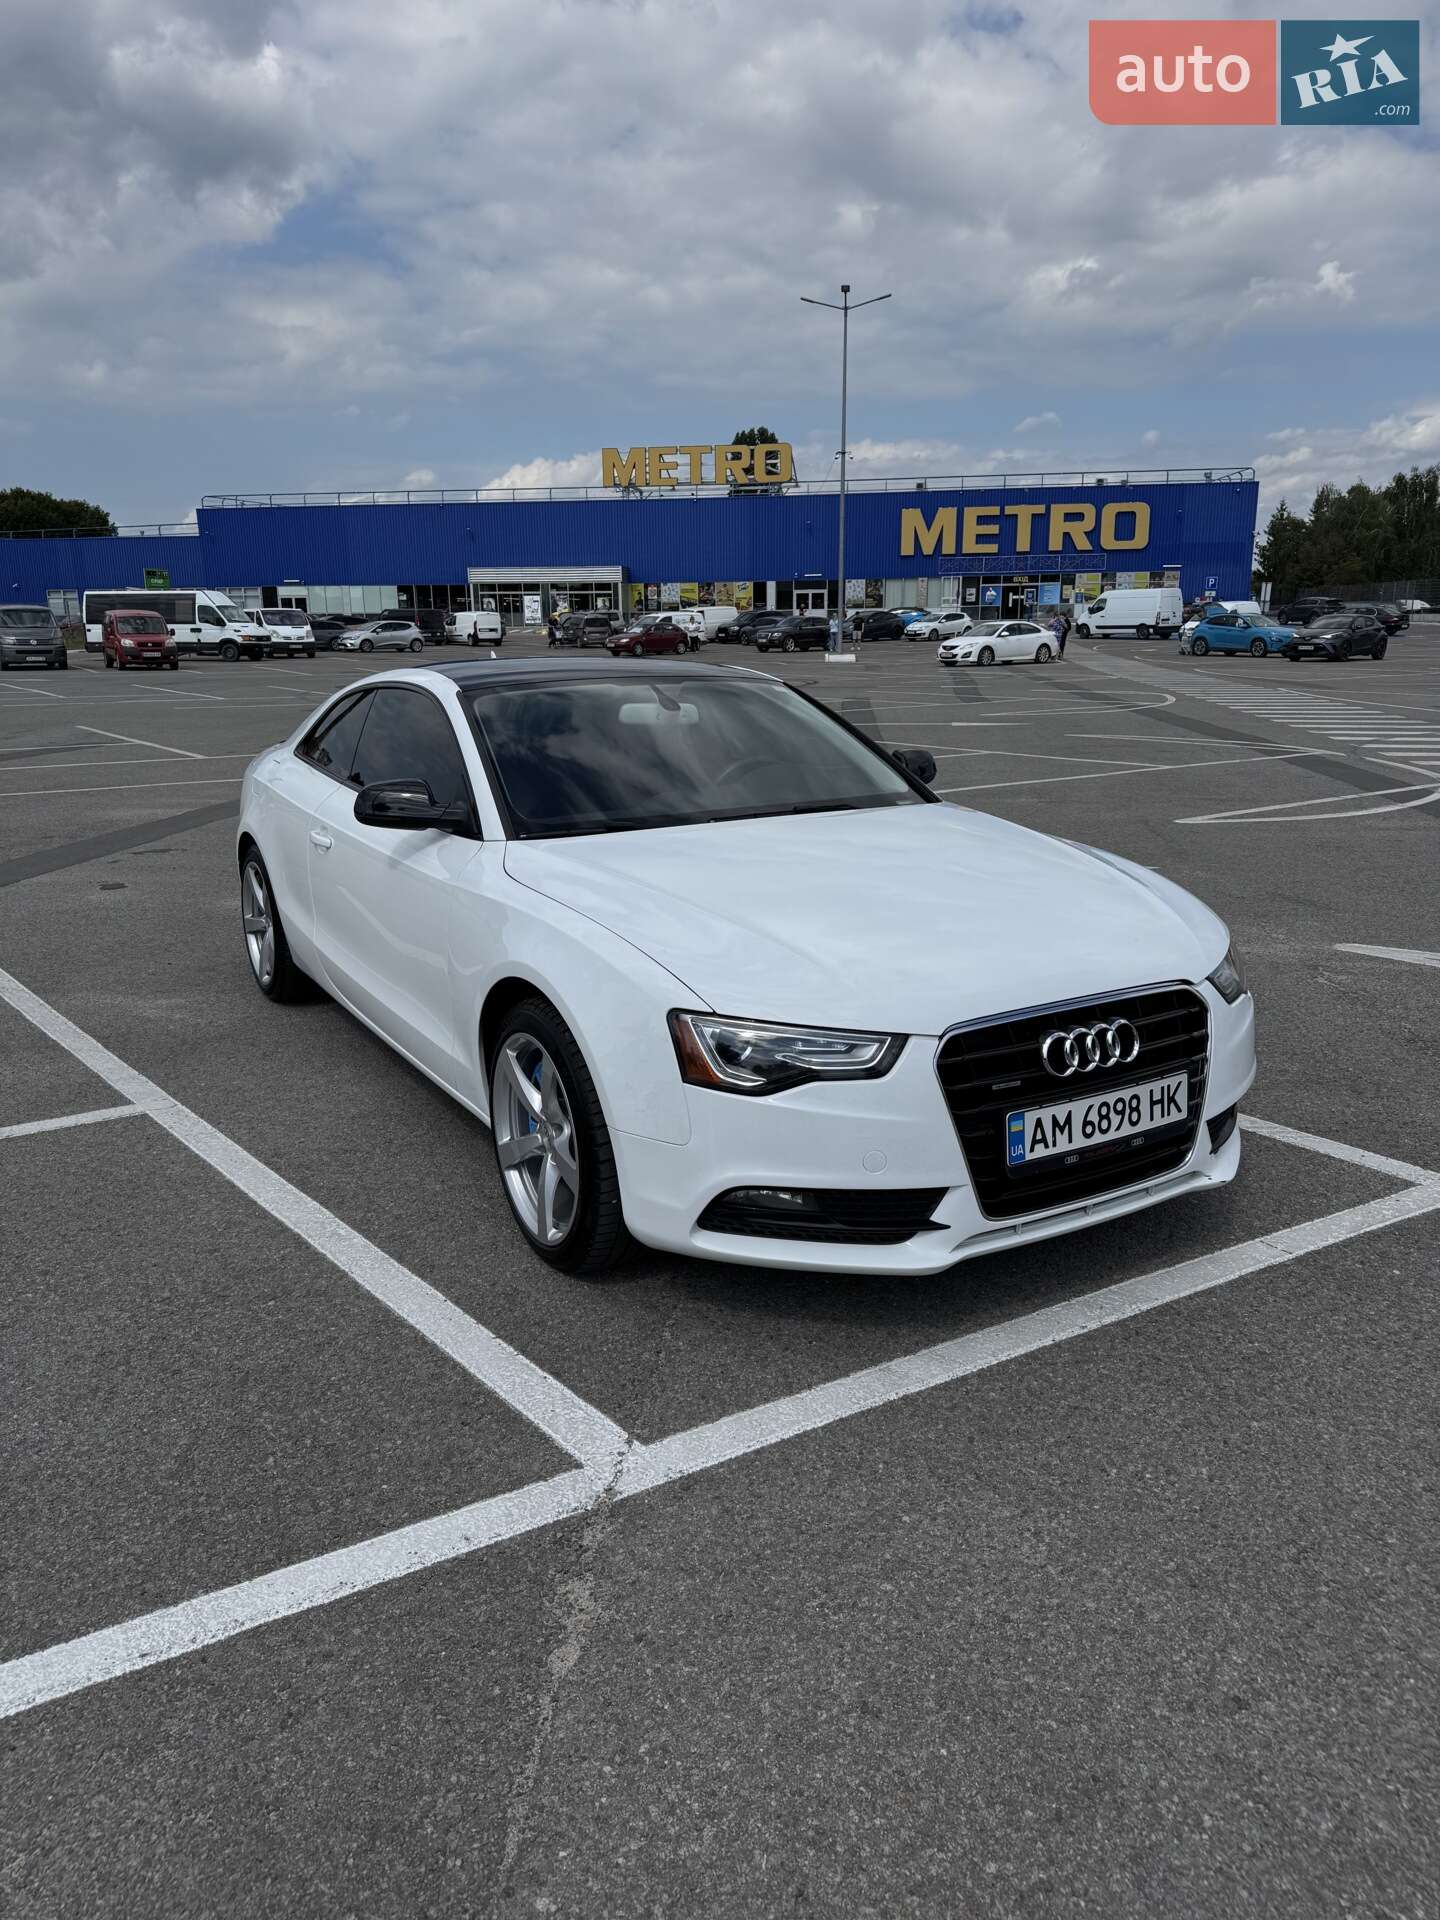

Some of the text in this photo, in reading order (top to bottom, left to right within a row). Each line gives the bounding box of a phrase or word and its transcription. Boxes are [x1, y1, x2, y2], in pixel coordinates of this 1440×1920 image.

[602, 443, 793, 488] METRO
[900, 502, 1151, 556] METRO
[1029, 1110, 1073, 1154] AM
[1081, 1093, 1141, 1140] 6898
[1149, 1081, 1184, 1122] HK
[1010, 1145, 1024, 1157] UA
